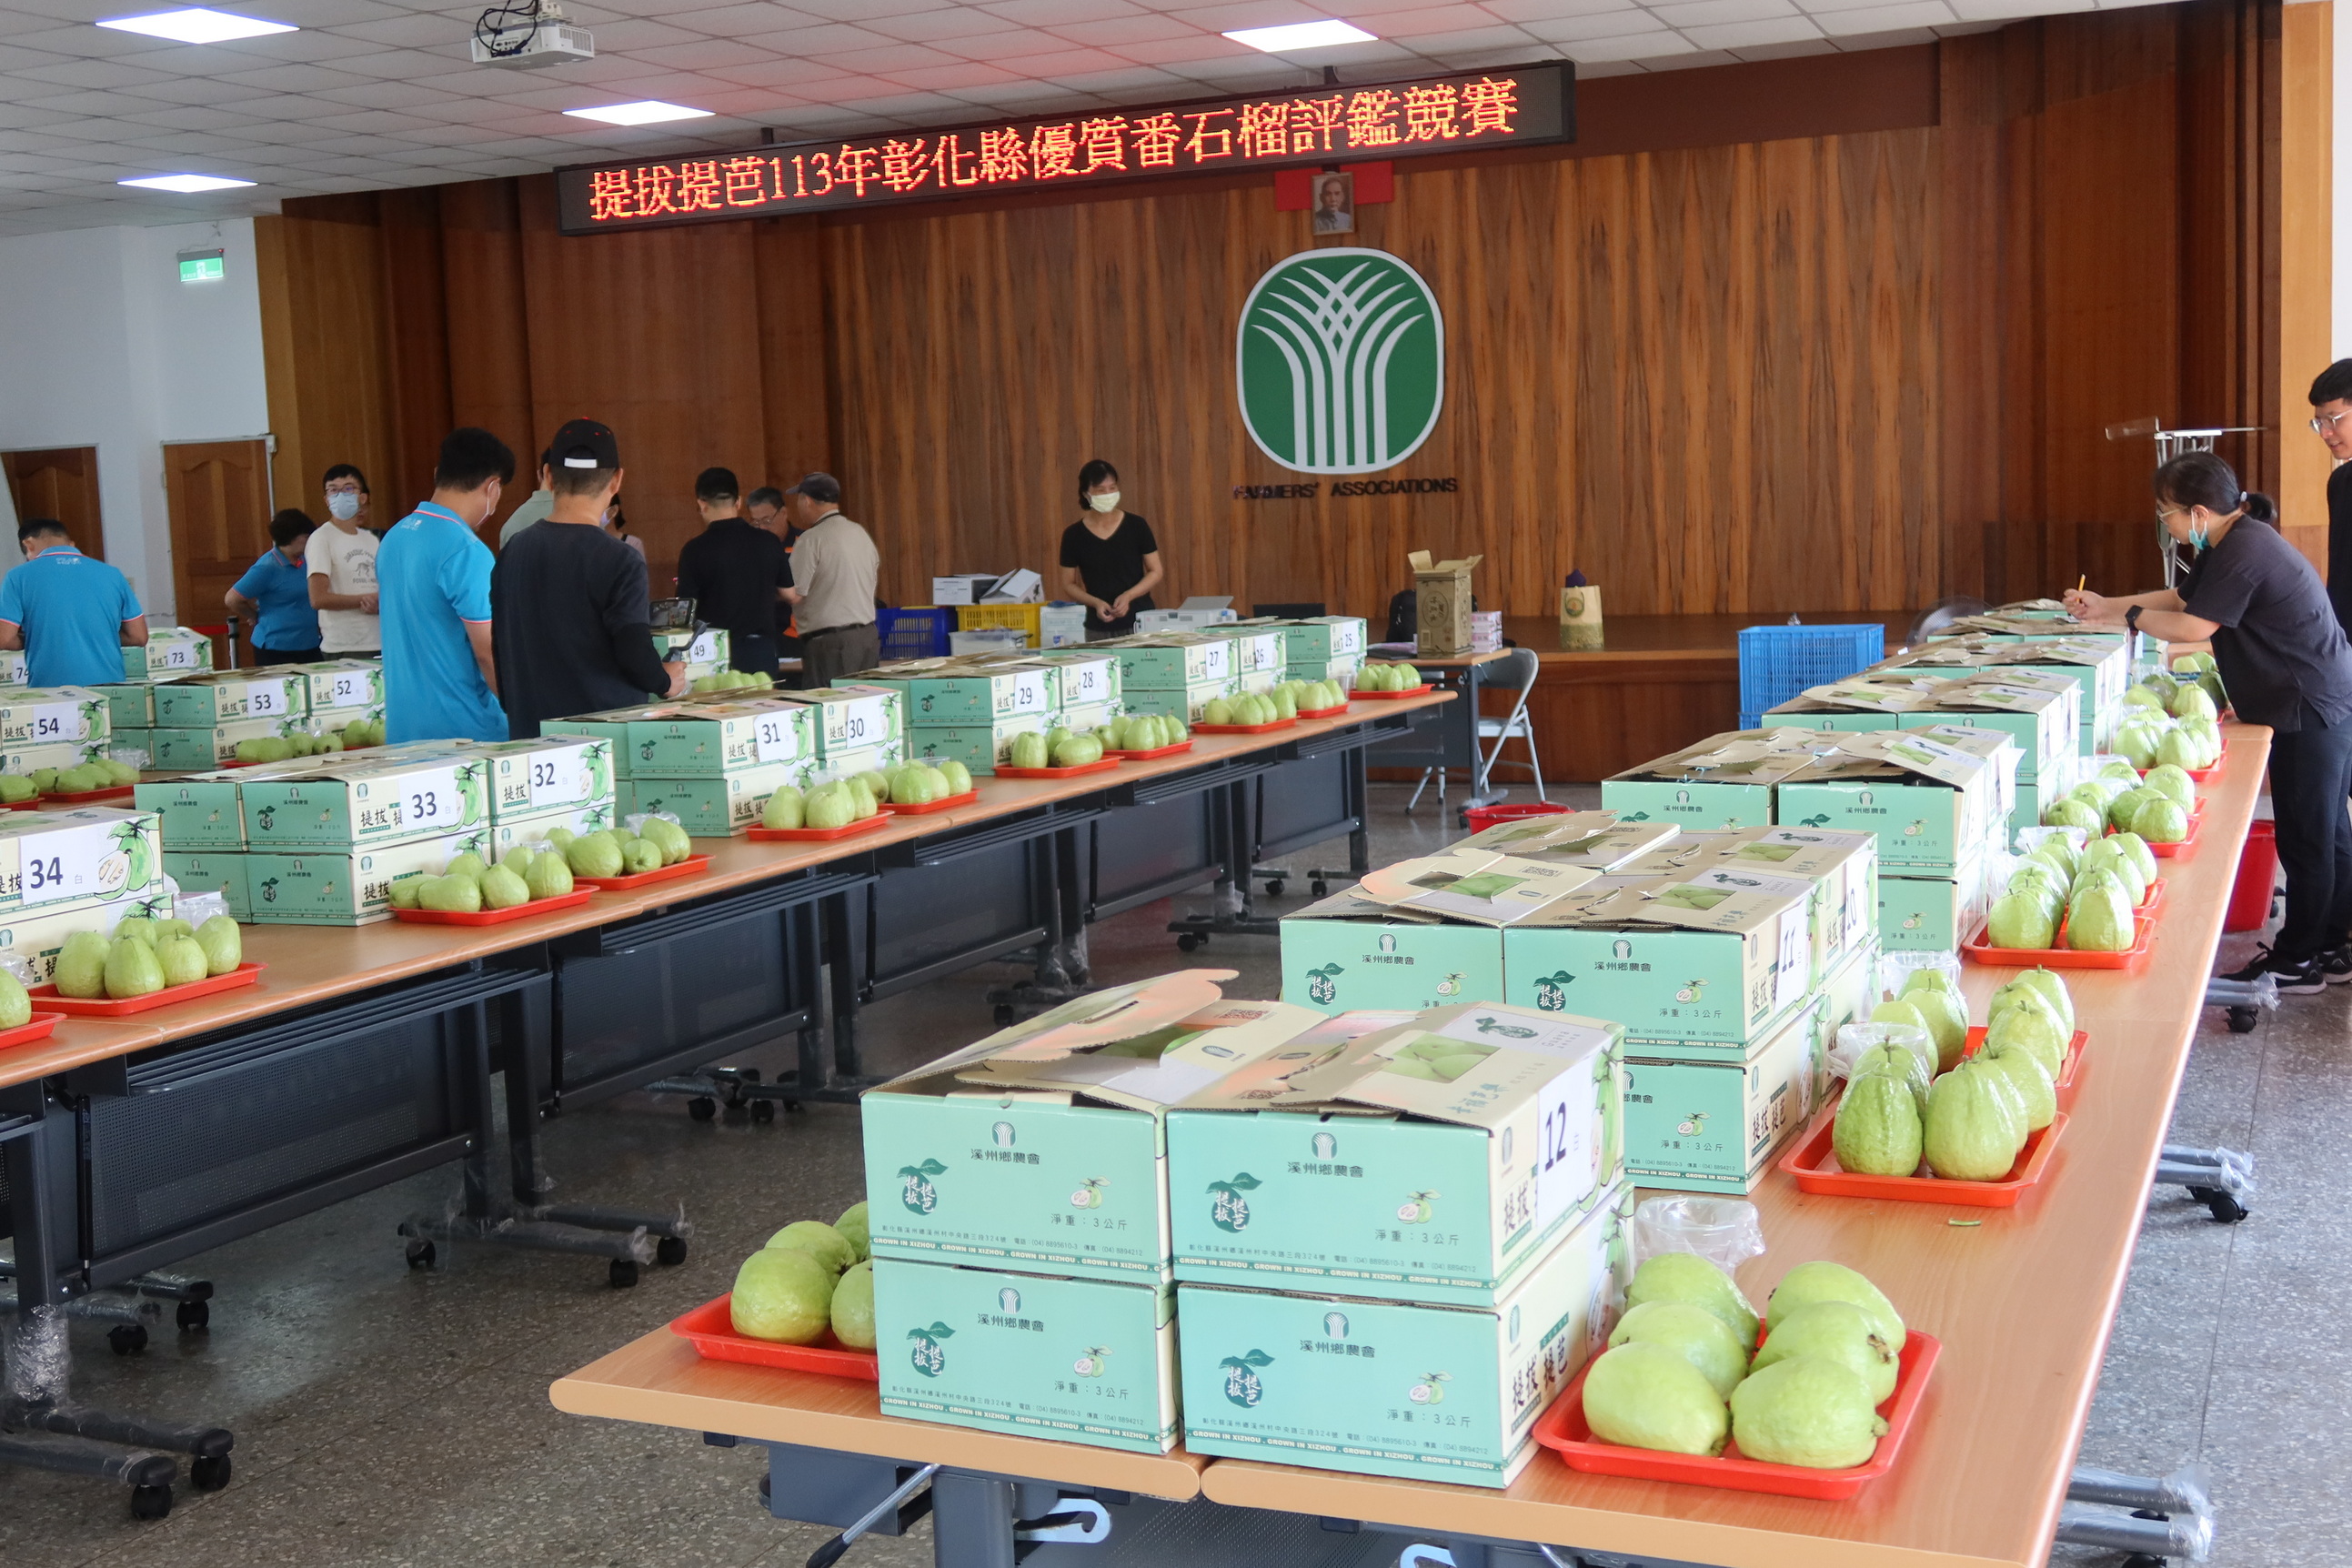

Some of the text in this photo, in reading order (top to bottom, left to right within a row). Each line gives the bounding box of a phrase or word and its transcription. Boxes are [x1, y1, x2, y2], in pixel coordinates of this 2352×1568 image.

[589, 76, 1517, 220] 提拔提芭113年彰化縣優質番石榴評鑑競賽
[1331, 477, 1458, 497] ASSOCIATIONS
[172, 652, 184, 664] 73
[694, 644, 705, 658] 49
[1209, 651, 1219, 667] 27
[1256, 648, 1264, 663] 26
[337, 680, 351, 695] 52
[1082, 671, 1093, 689] 28
[255, 694, 271, 710] 53
[1020, 687, 1032, 705] 29
[38, 718, 59, 735] 54
[761, 723, 780, 744] 31
[849, 718, 864, 739] 30
[534, 762, 555, 788] 32
[412, 791, 437, 819] 33
[30, 857, 63, 889] 34
[1782, 928, 1796, 973] 11
[1544, 1101, 1567, 1173] 12
[970, 1149, 1040, 1165] 溪州鄉農會
[1287, 1161, 1363, 1179] 溪州鄉農會
[874, 1237, 899, 1246] GROWN
[910, 1241, 936, 1250] XIZHOU
[941, 1244, 967, 1252] GROWN
[978, 1248, 1005, 1257] XIZHOU
[1010, 1251, 1037, 1260] GROWN
[1048, 1255, 1076, 1263] XIZHOU
[1081, 1258, 1109, 1267] GROWN
[1120, 1261, 1148, 1271] XIZHOU
[1180, 1257, 1207, 1266] GROWN
[1219, 1261, 1248, 1269] XIZHOU
[1253, 1263, 1282, 1271] GROWN
[1294, 1267, 1324, 1275] XIZHOU
[1330, 1270, 1359, 1278] GROWN
[1372, 1272, 1402, 1282] XIZHOU
[1408, 1276, 1439, 1284] GROWN
[1452, 1279, 1483, 1288] XIZHOU
[977, 1312, 1045, 1332] 溪州鄉農會
[1299, 1339, 1376, 1359] 溪州鄉農會
[884, 1398, 909, 1406] GROWN
[918, 1402, 944, 1411] XIZHOU
[949, 1406, 973, 1415] GROWN
[983, 1411, 1010, 1421] XIZHOU
[1015, 1416, 1041, 1425] GROWN
[1051, 1421, 1079, 1431] XIZHOU
[1084, 1425, 1111, 1435] GROWN
[1121, 1430, 1149, 1441] XIZHOU
[1192, 1431, 1221, 1439] GROWN
[1232, 1434, 1261, 1443] XIZHOU
[1267, 1439, 1295, 1447] GROWN
[1307, 1443, 1337, 1452] XIZHOU
[1342, 1447, 1372, 1456] GROWN
[1384, 1451, 1414, 1461] XIZHOU
[1422, 1454, 1451, 1464] GROWN
[1462, 1460, 1494, 1470] XIZHOU
